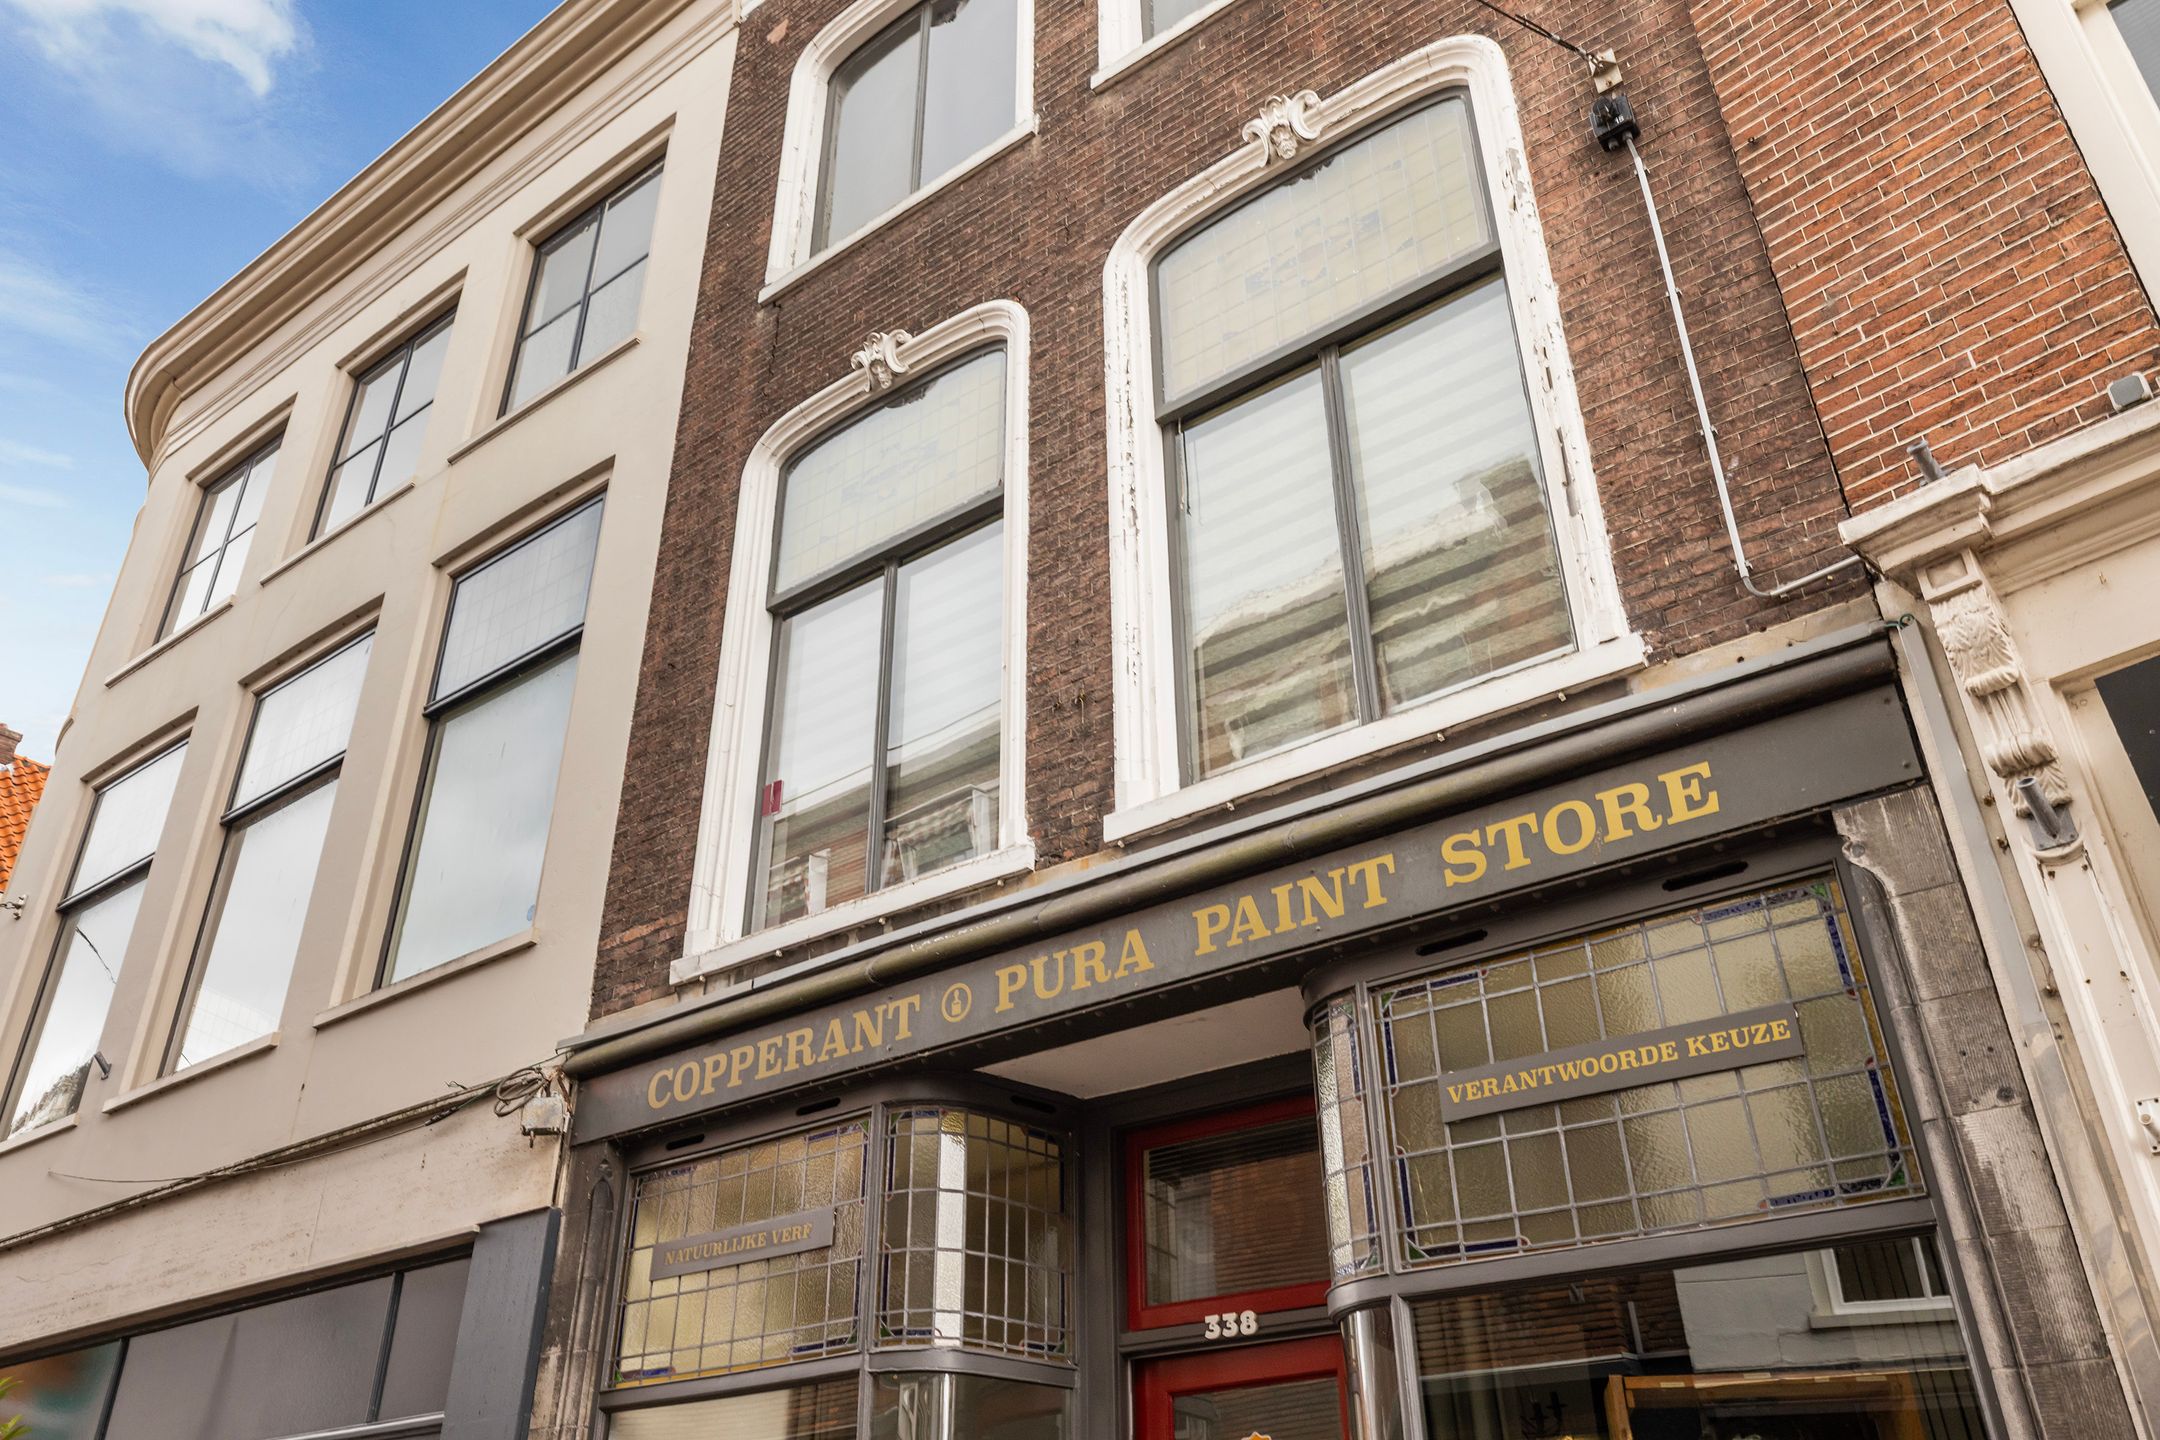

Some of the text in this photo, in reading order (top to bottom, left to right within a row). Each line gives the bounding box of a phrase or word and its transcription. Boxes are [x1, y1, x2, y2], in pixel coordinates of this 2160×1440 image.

[648, 760, 1720, 1109] COPPERANT PURA PAINT STORE
[1447, 1018, 1792, 1104] VERANTWOORDE KEUZE
[664, 1223, 813, 1265] NATUURLIJKE VERF
[1204, 1310, 1259, 1340] 338
